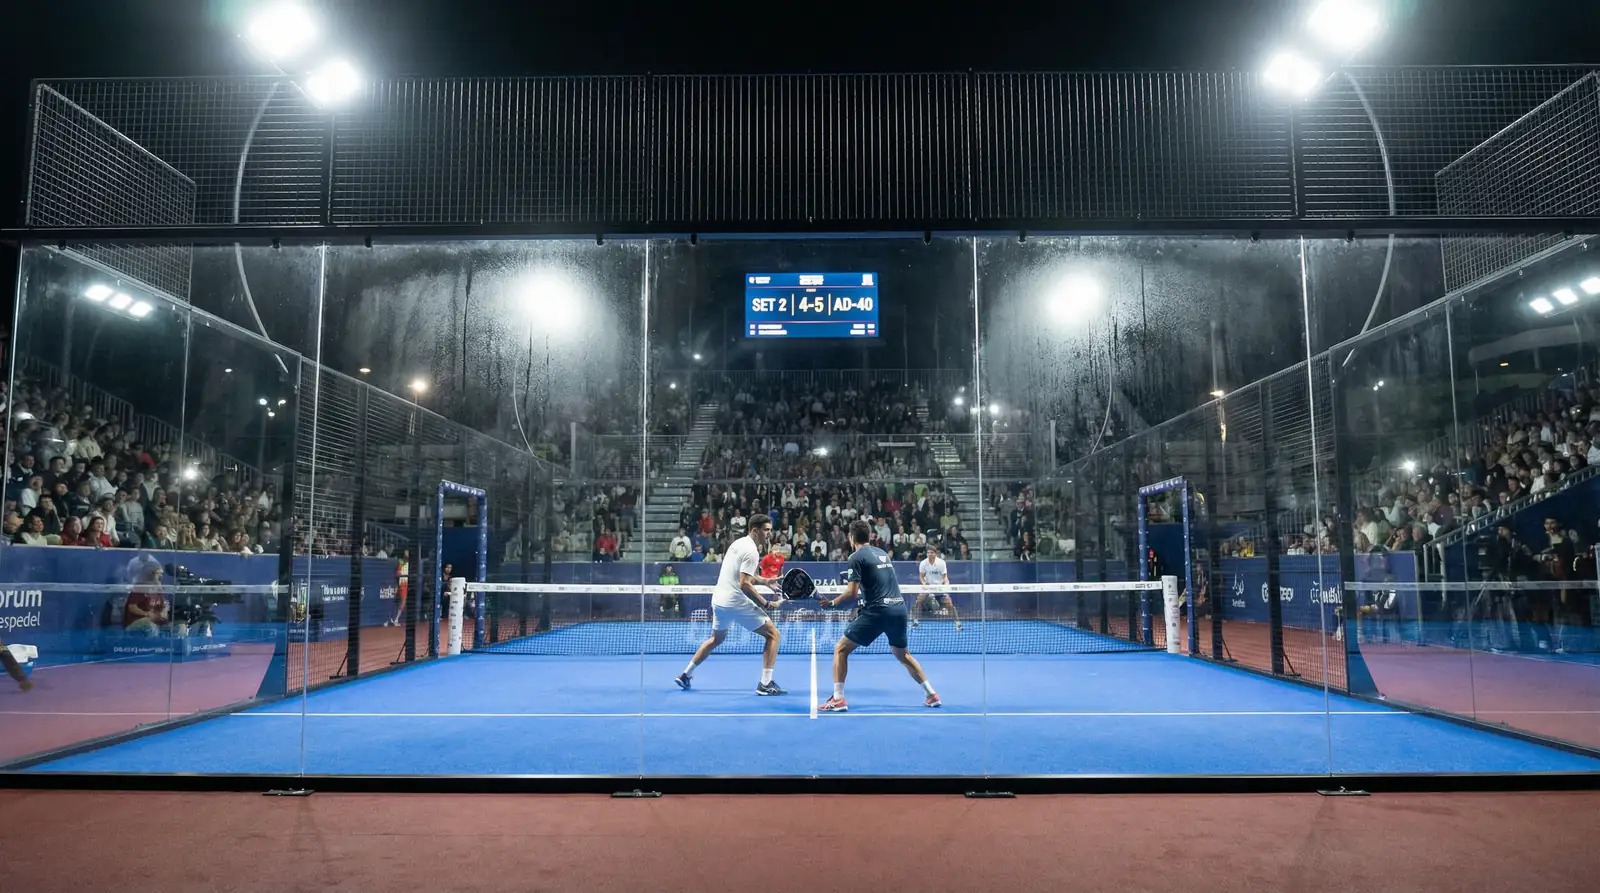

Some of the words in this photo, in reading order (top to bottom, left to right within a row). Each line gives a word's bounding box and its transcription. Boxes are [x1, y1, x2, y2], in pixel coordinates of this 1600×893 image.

[752, 297, 776, 312] SET
[778, 298, 787, 312] 2
[798, 296, 824, 313] 4-5
[833, 297, 873, 311] AD-40
